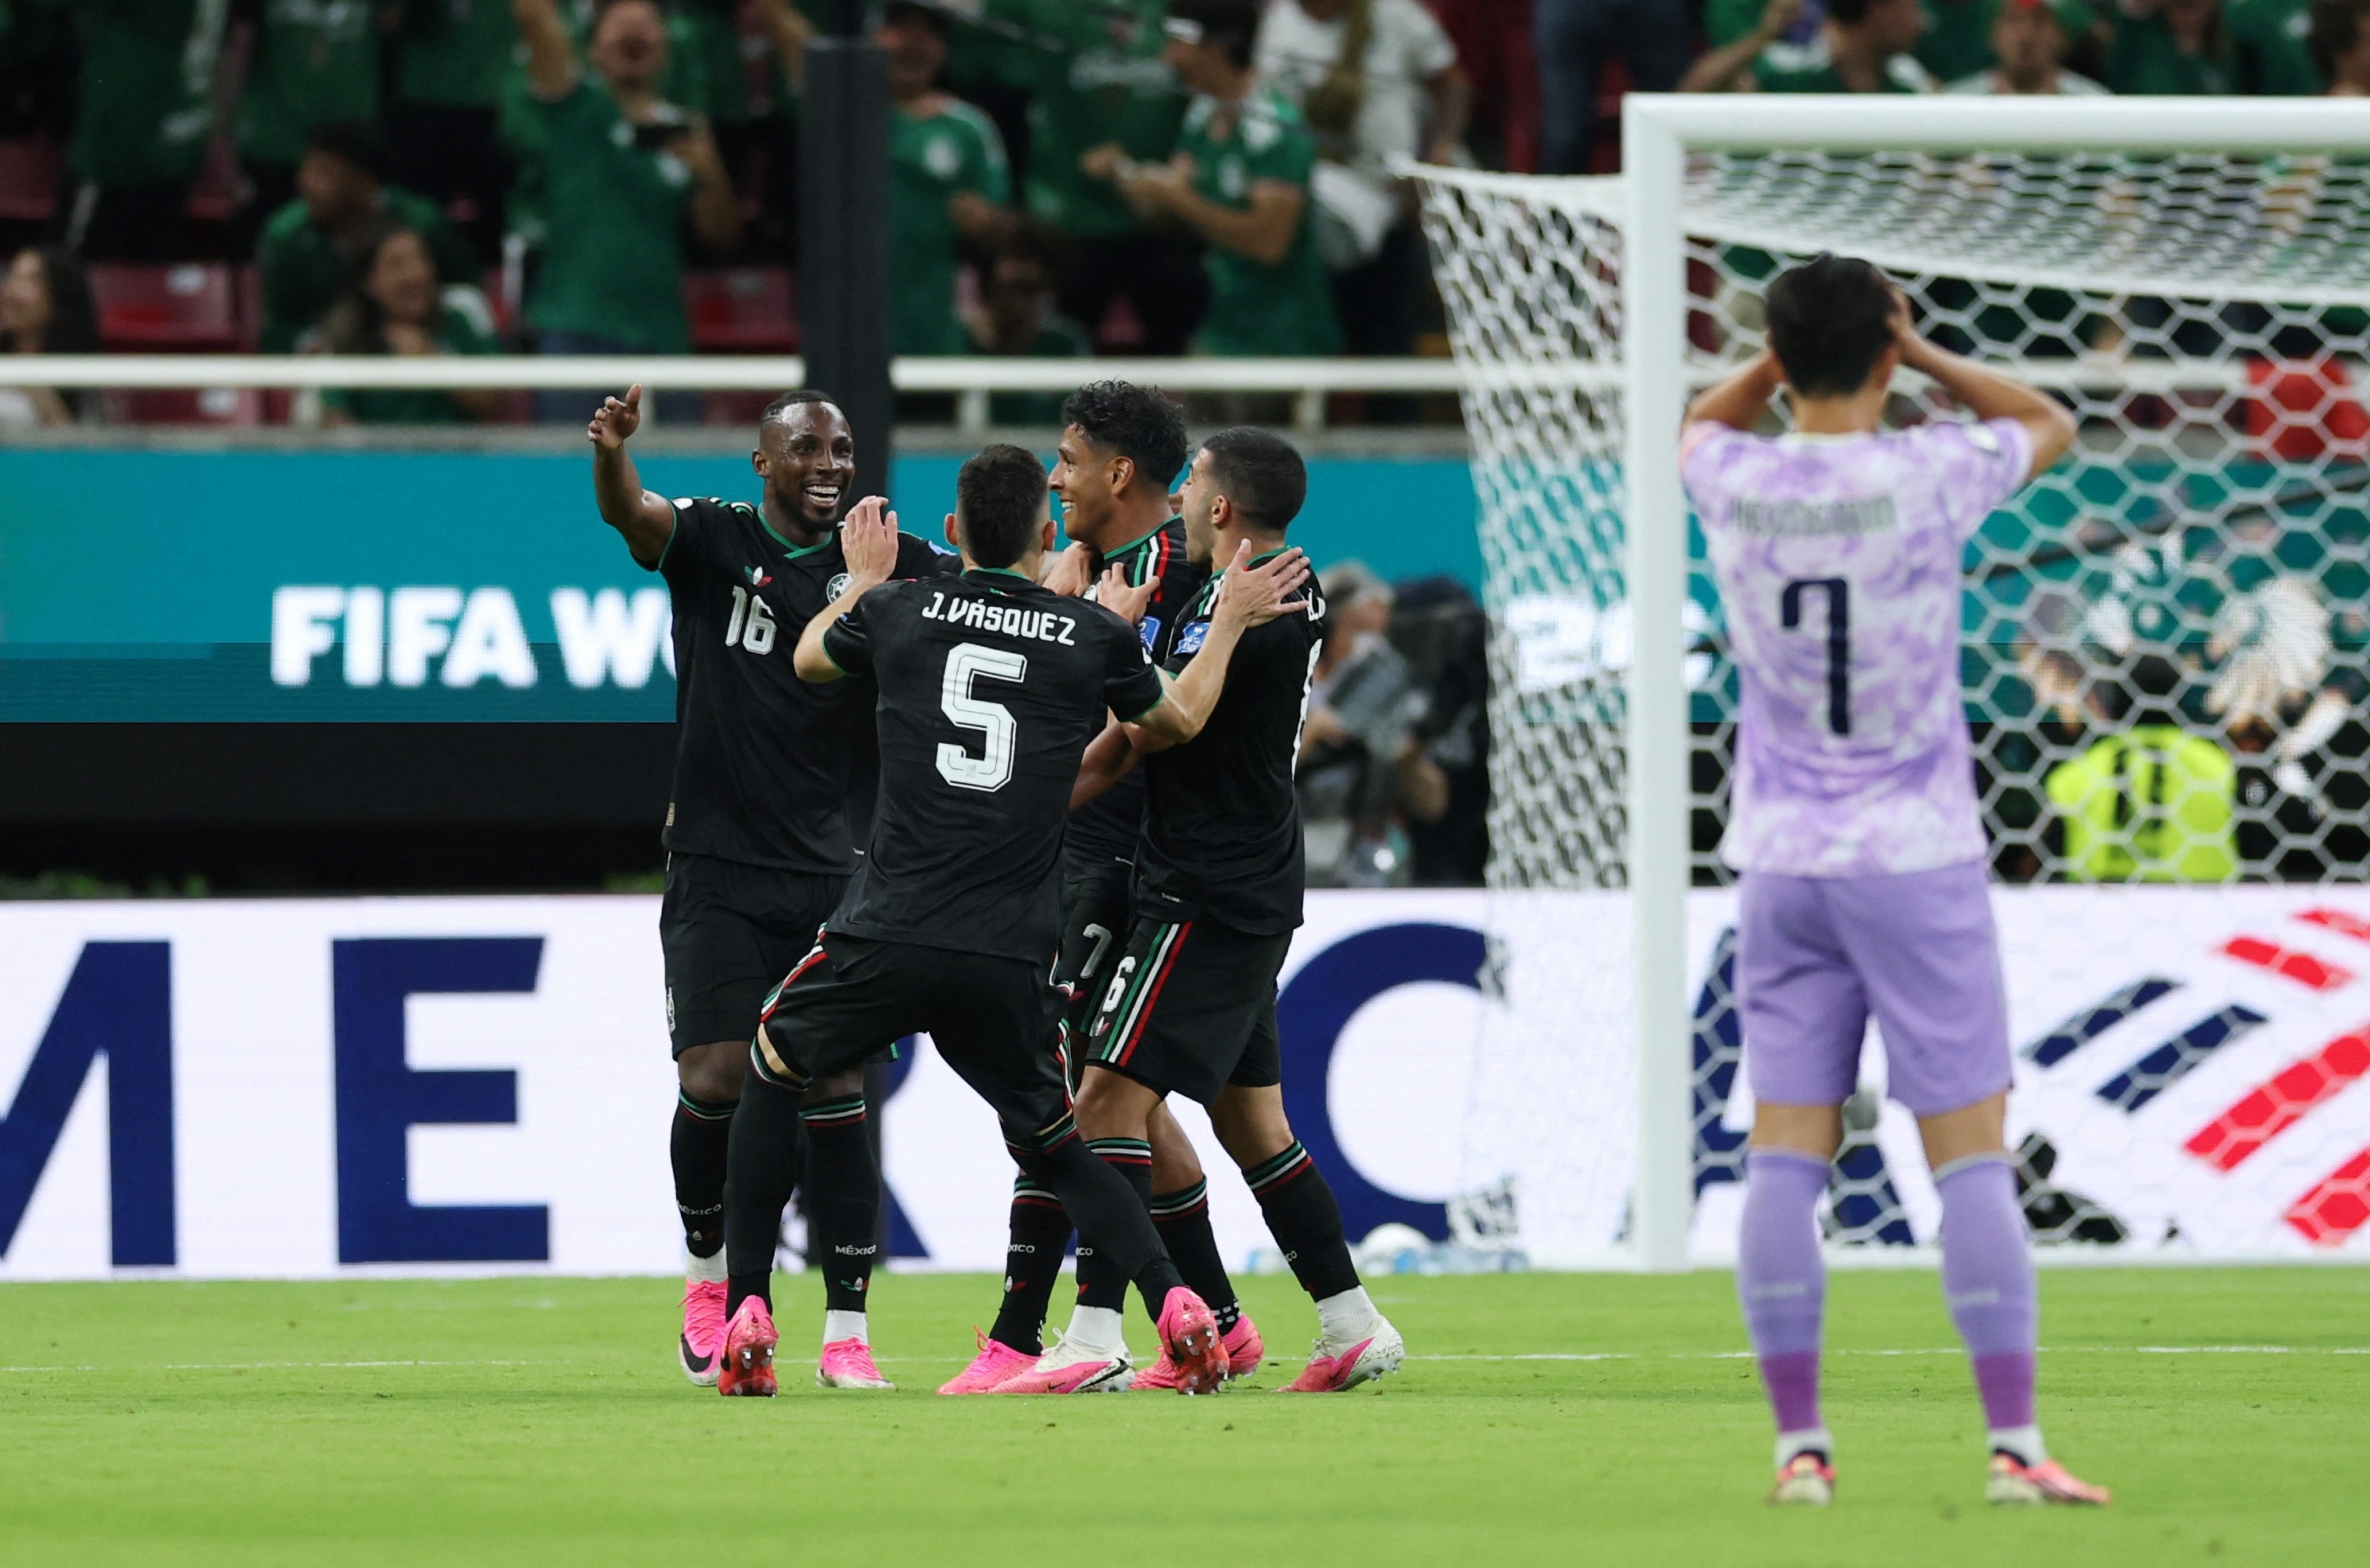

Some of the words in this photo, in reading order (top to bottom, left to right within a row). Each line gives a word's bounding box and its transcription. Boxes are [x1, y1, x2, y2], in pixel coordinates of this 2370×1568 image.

[270, 586, 538, 688] FIFA
[726, 585, 777, 656] 16
[921, 591, 1076, 646] J.VÁSQUEZ
[1781, 578, 1850, 737] 7
[936, 642, 1028, 792] 5
[1080, 923, 1113, 979] 7
[1102, 956, 1136, 1012] 6
